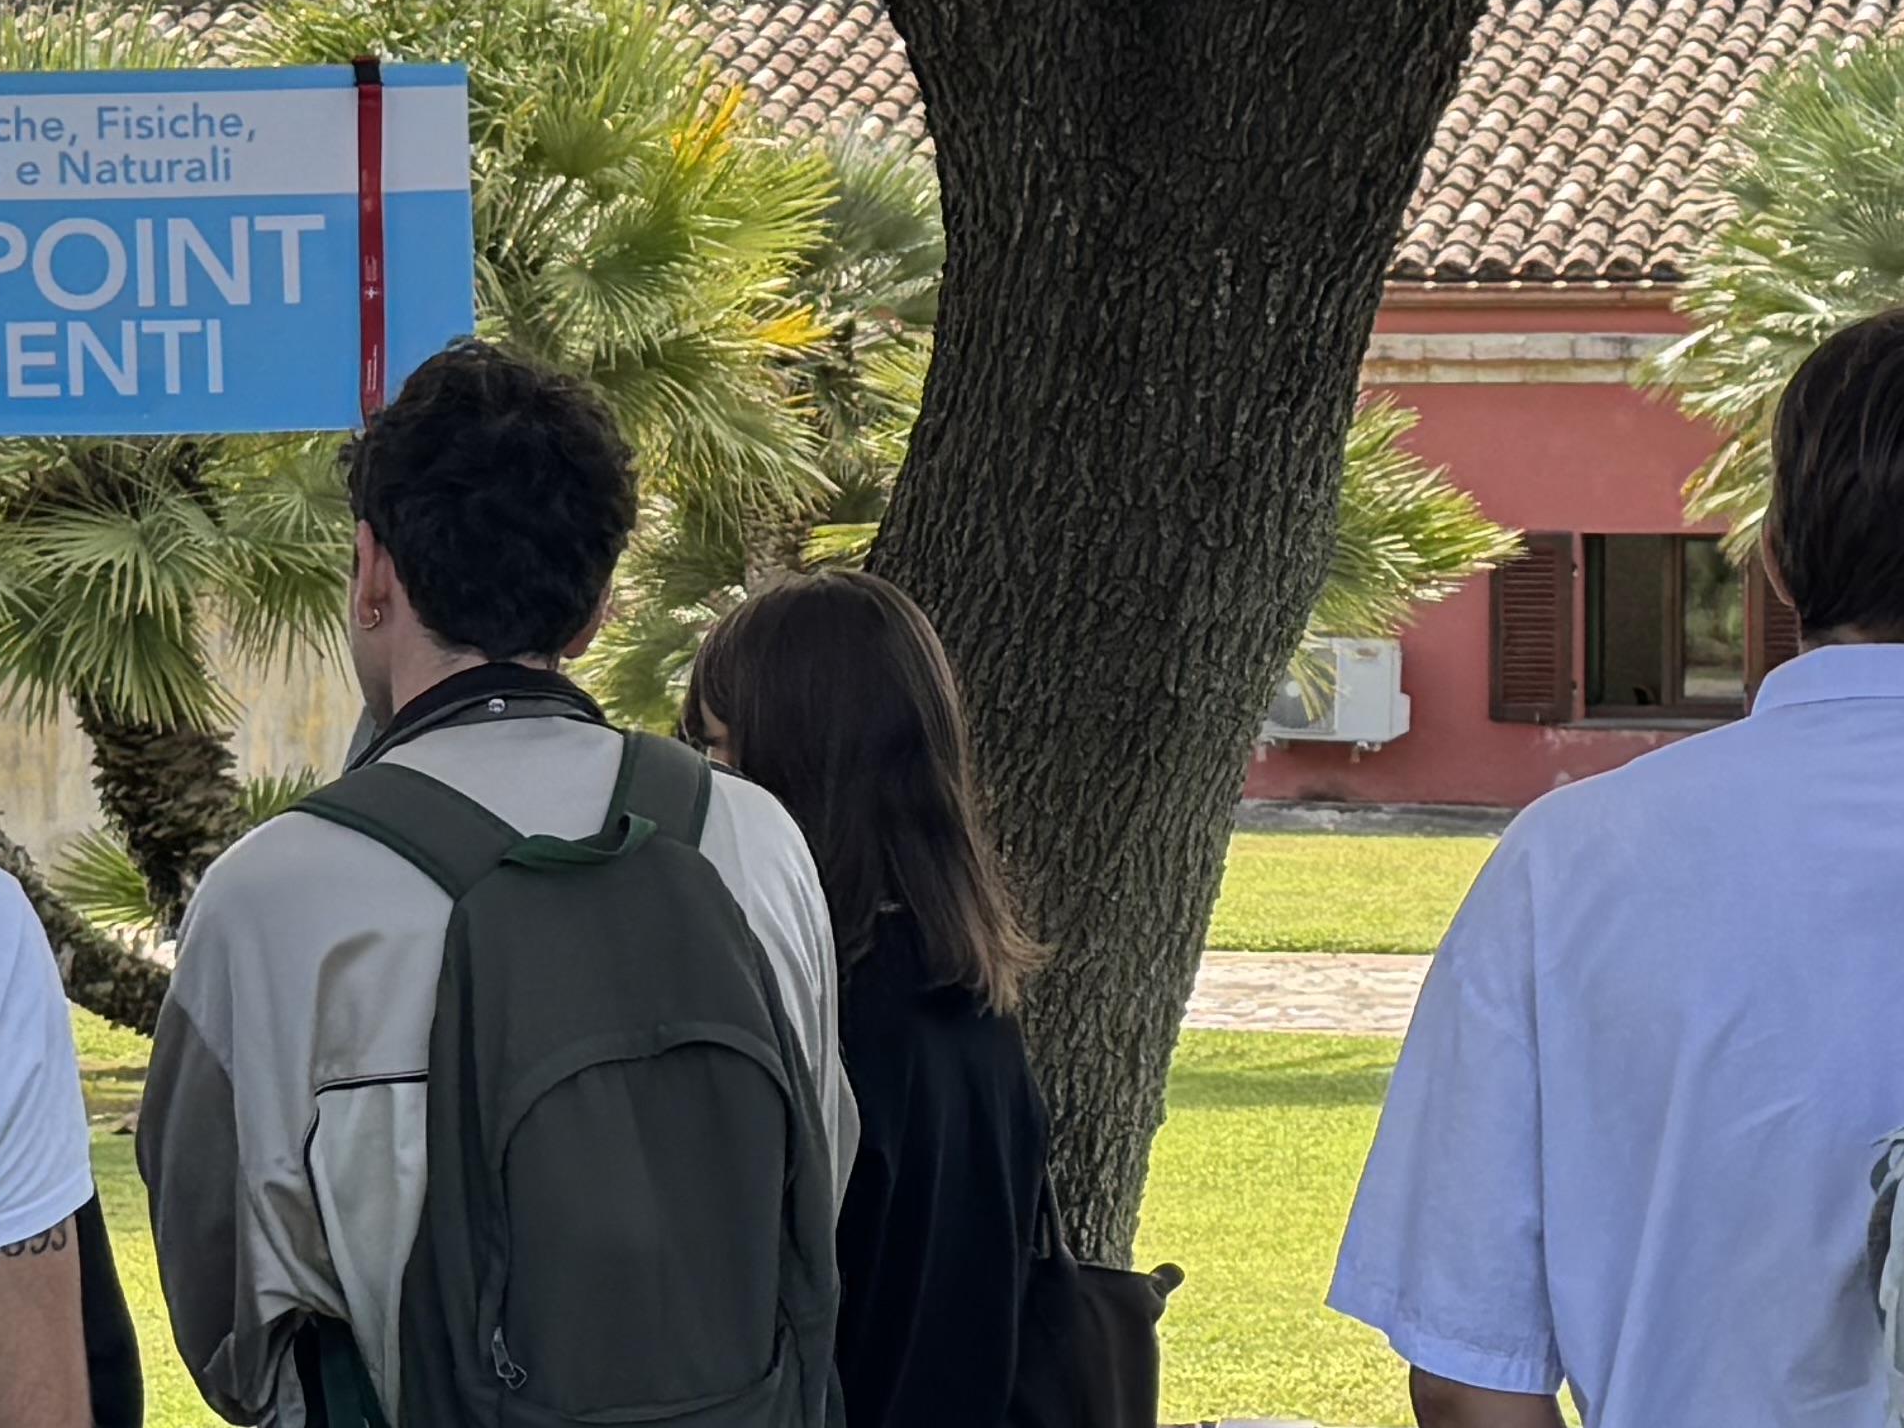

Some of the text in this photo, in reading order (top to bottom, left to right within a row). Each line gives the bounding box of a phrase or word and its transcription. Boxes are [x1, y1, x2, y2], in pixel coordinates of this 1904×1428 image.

[97, 102, 256, 144] Fisiche,
[16, 162, 38, 186] e
[57, 146, 232, 185] Naturali
